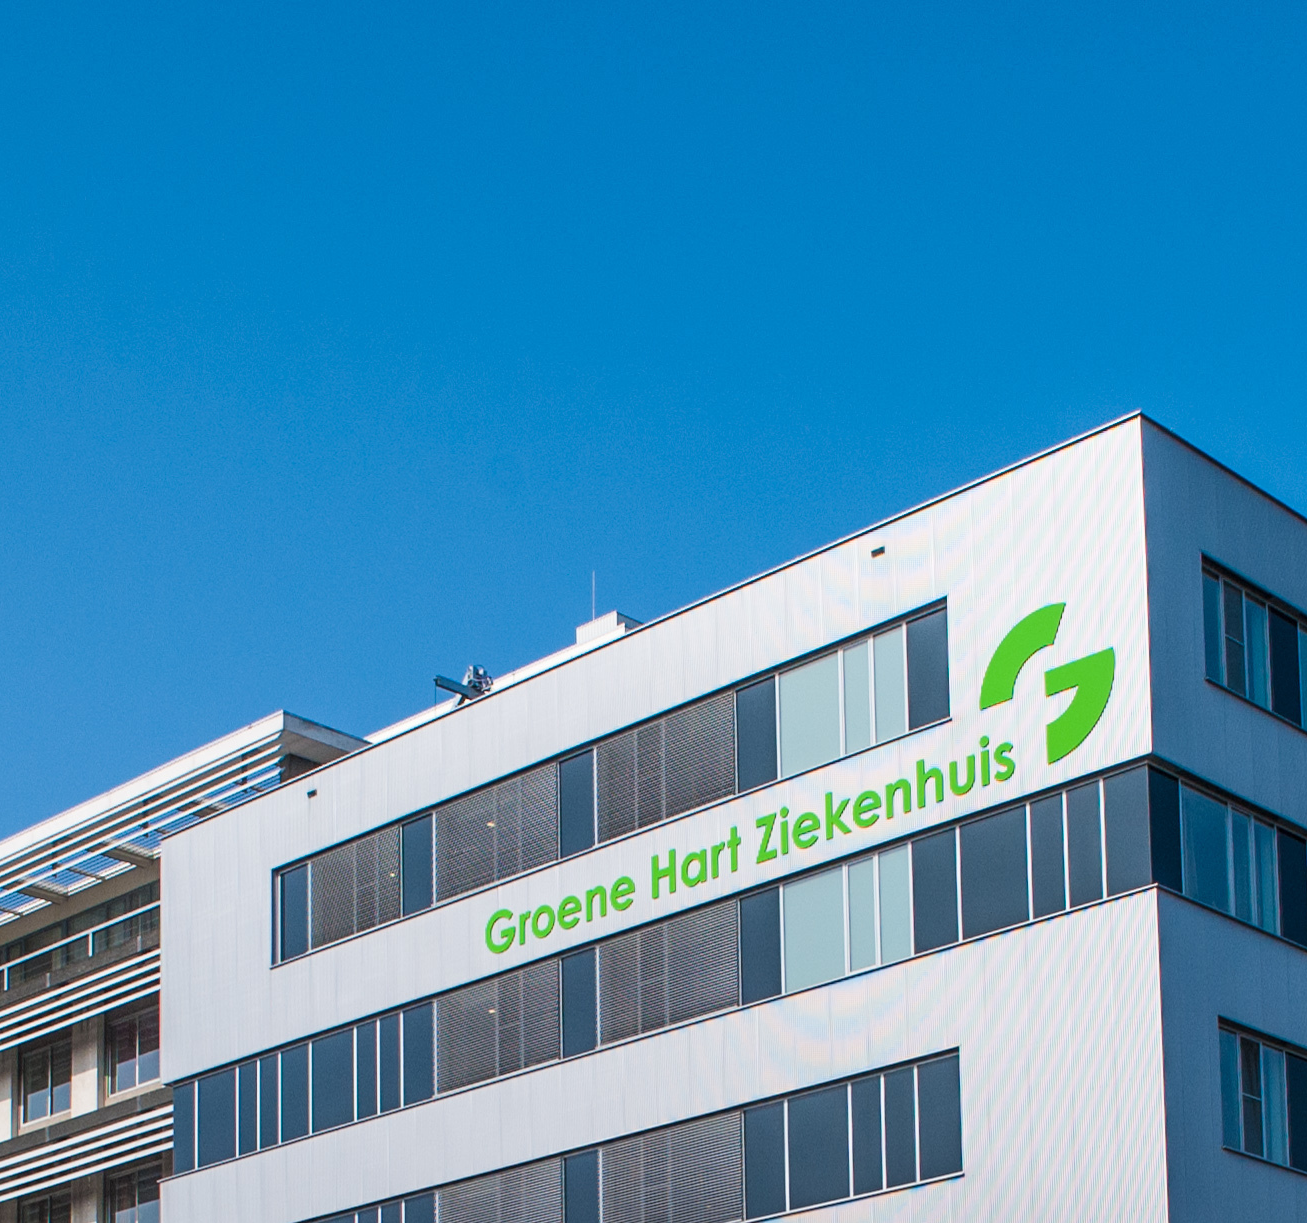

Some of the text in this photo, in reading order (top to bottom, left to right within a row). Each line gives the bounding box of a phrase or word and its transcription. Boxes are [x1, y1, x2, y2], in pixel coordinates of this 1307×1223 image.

[484, 735, 1016, 954] Groene Hart Ziekenhuis
